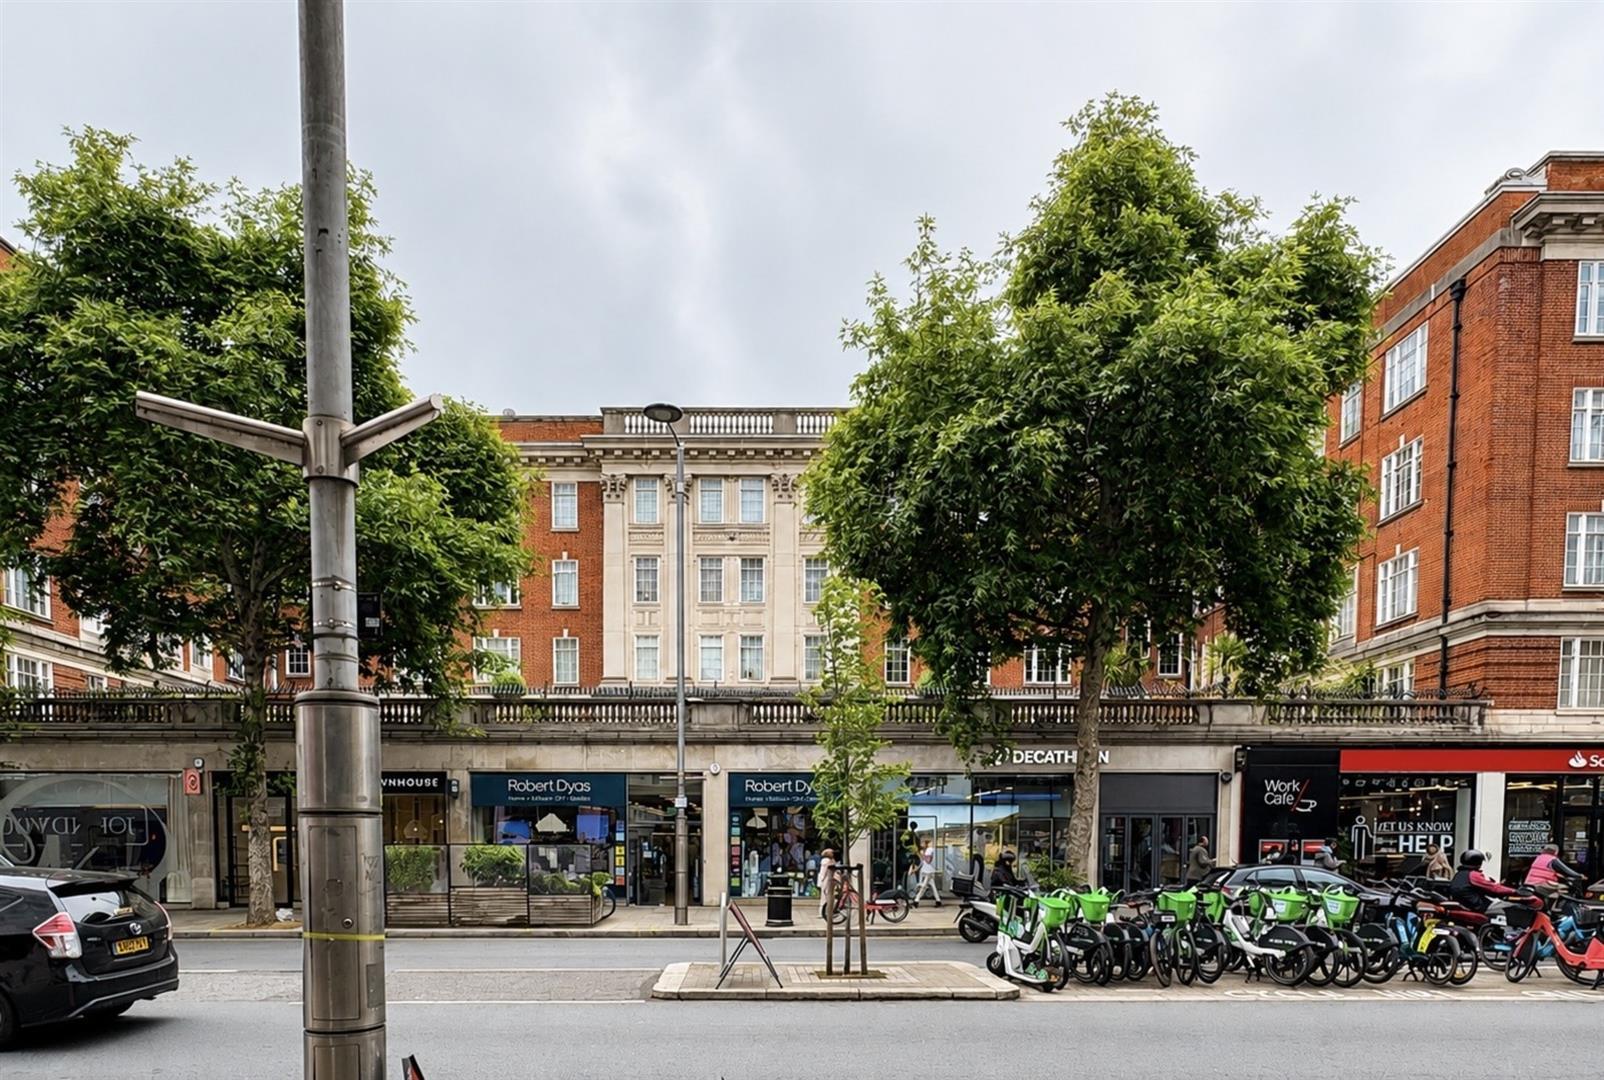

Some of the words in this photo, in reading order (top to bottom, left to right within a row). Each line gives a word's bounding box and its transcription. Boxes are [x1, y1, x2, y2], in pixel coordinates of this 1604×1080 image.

[1012, 750, 1109, 764] DECATHN
[508, 779, 554, 792] Robert
[556, 779, 591, 795] Dyas
[745, 779, 793, 792] Robert
[1264, 779, 1300, 792] Work
[1398, 821, 1414, 831] US
[1416, 821, 1453, 831] KNOW
